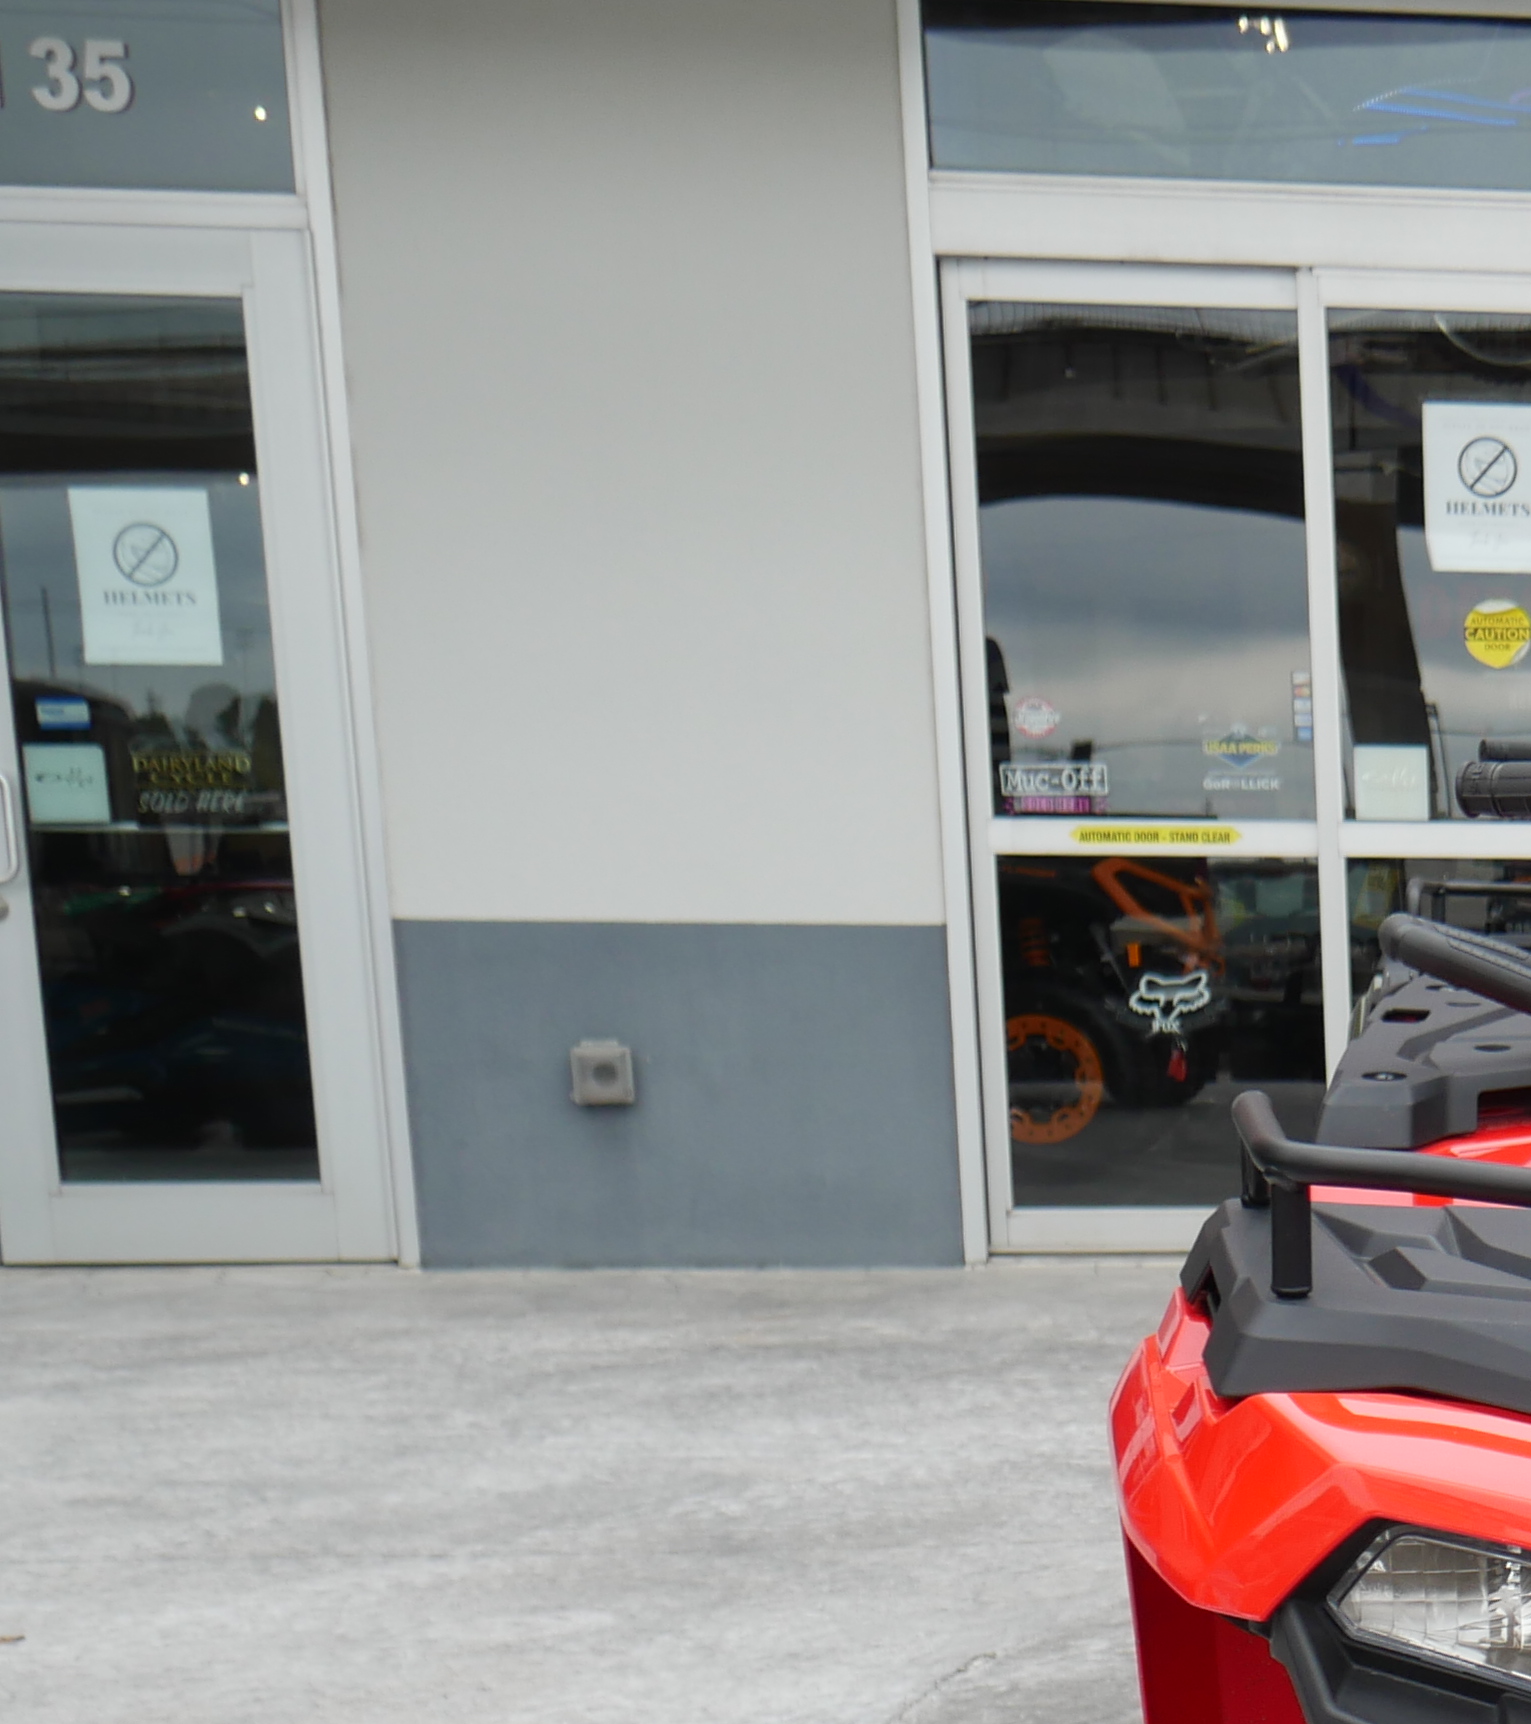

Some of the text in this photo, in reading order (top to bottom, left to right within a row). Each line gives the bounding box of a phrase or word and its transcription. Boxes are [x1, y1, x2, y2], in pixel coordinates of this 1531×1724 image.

[29, 37, 136, 113] 35
[1446, 502, 1530, 517] HELMETS
[104, 590, 197, 606] HELMETS
[1470, 616, 1524, 626] AUTOMATIC
[1464, 628, 1530, 641] CAUTION
[1484, 642, 1511, 651] DOOR
[132, 754, 251, 774] DAIRYLAND
[1004, 768, 1103, 792] Muc-Off
[138, 792, 190, 814] SOLD
[1079, 832, 1132, 843] AUTOMATIC
[1134, 832, 1160, 843] DOOR
[1169, 832, 1199, 843] STAND
[1201, 832, 1230, 844] CLEAR
